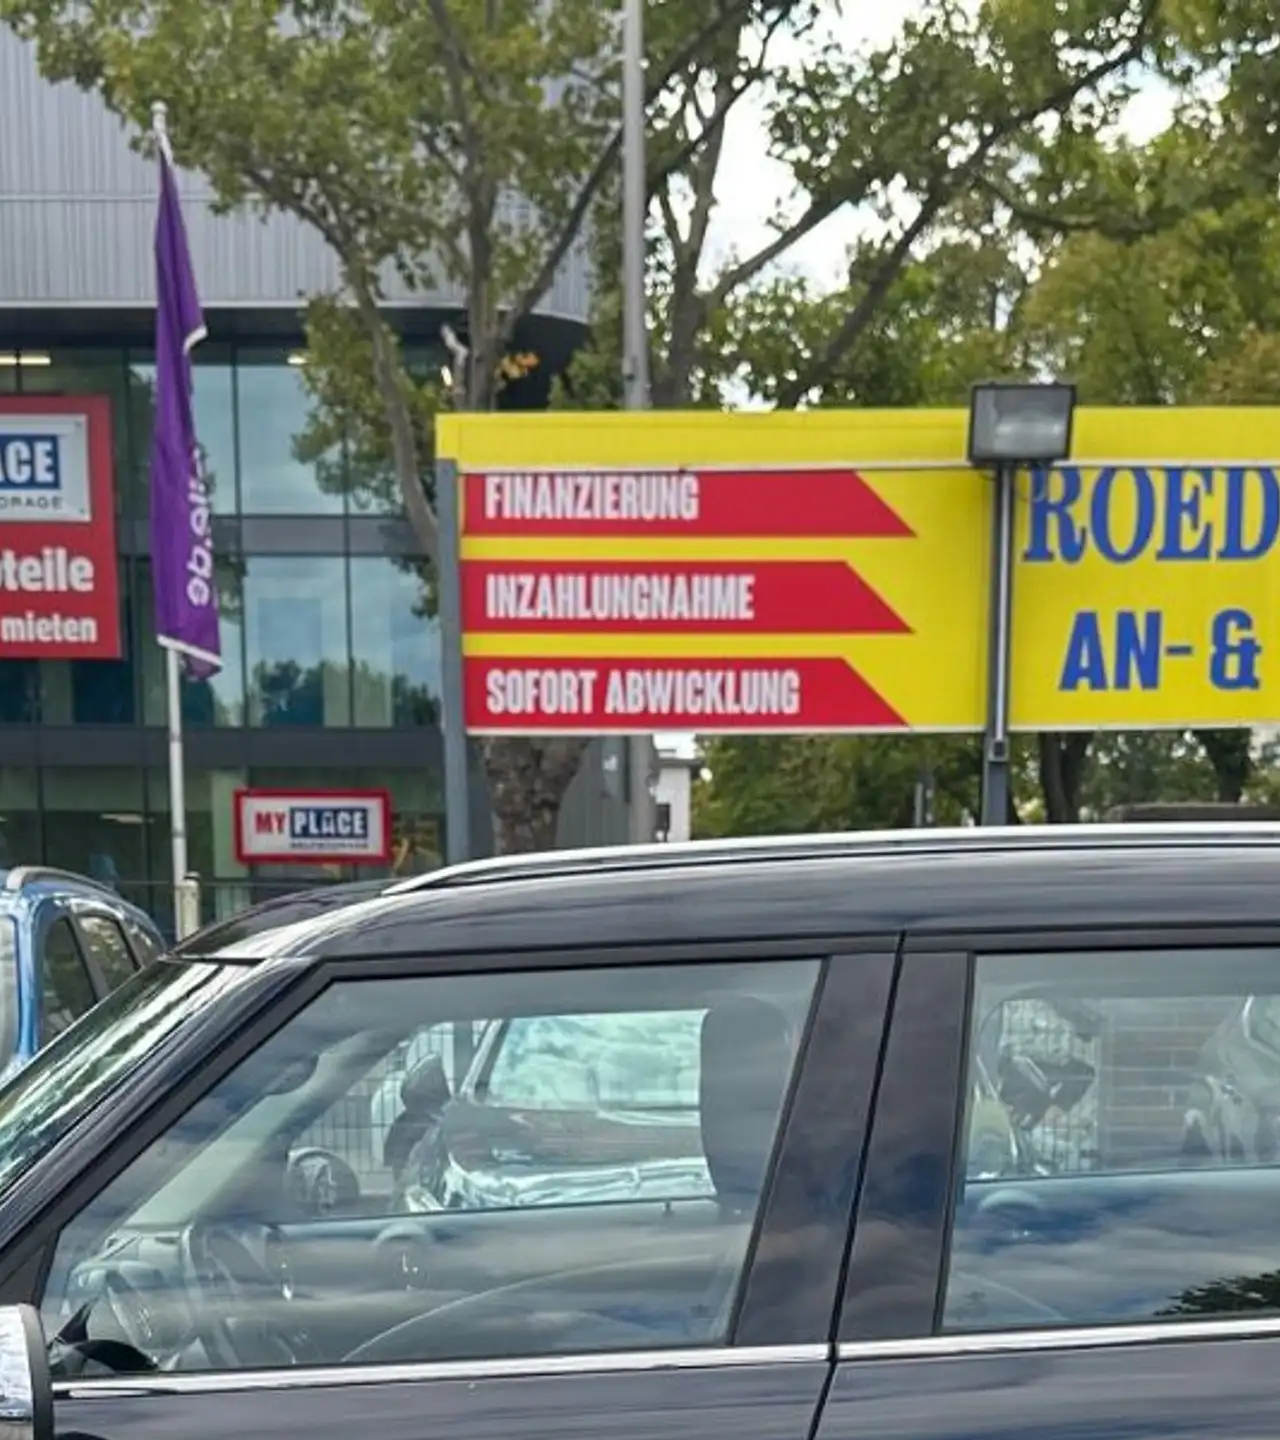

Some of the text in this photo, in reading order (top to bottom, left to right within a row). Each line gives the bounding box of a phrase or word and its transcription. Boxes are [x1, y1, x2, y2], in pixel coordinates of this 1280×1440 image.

[484, 474, 699, 521] FINANZIERUNG
[485, 573, 755, 621] INZAHLUNGNAHME
[0, 611, 98, 643] mieten
[1058, 610, 1194, 691] AN-
[1209, 608, 1261, 690] &
[485, 669, 800, 714] SOFORT ABWICKLUNG
[255, 810, 366, 836] MY PLACE
